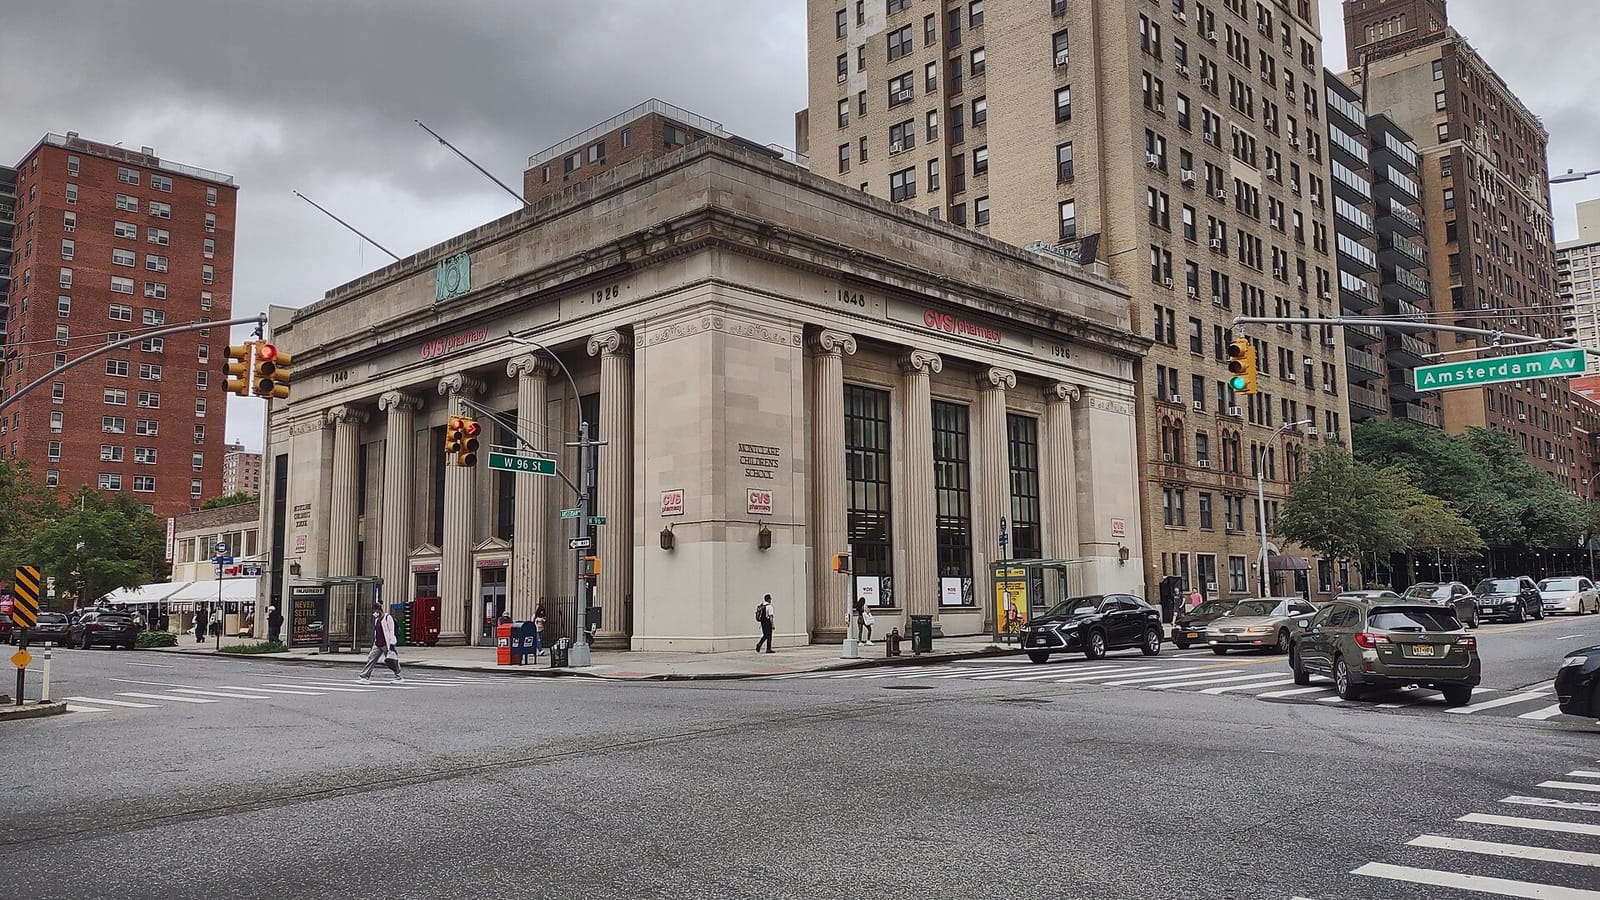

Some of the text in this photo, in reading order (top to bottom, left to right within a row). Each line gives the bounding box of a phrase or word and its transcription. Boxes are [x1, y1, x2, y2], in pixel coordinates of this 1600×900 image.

[591, 284, 619, 305] 1926
[838, 289, 865, 307] 1848
[1051, 344, 1070, 359] 1926
[1424, 356, 1577, 385] Amsterdam Av
[738, 443, 780, 456] MONTCLARE
[504, 457, 542, 471] W 96 St
[740, 456, 778, 468] CHILDREN'S
[745, 469, 774, 479] SCHOOL
[663, 494, 681, 505] CVS
[750, 492, 771, 504] CVS
[294, 609, 317, 617] SETTLE
